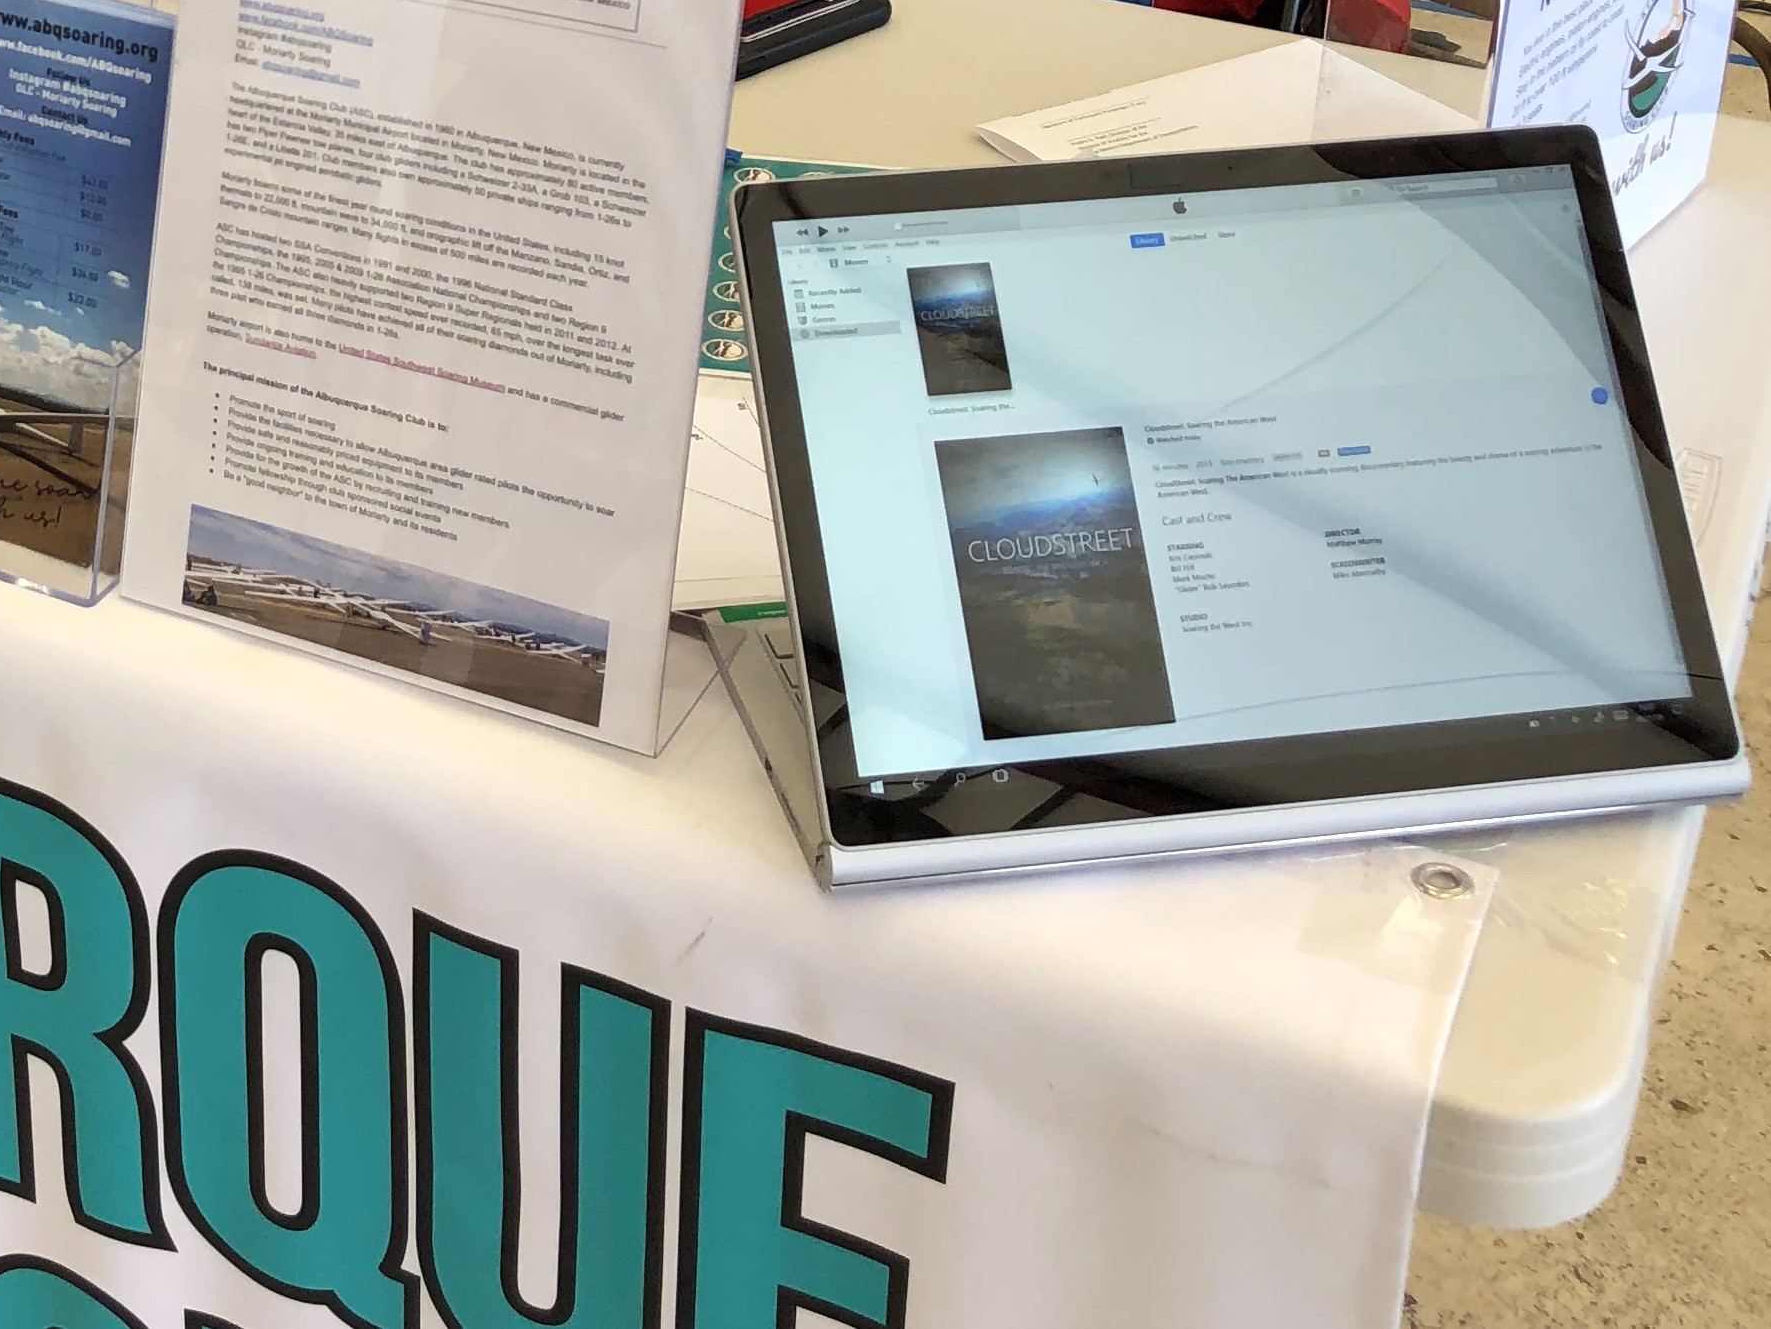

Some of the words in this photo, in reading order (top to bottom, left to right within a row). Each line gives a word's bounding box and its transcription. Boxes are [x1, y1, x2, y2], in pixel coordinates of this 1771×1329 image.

[920, 304, 995, 322] CLOUDSTREET
[23, 505, 63, 529] us!
[968, 527, 1134, 563] CLOUDSTREET
